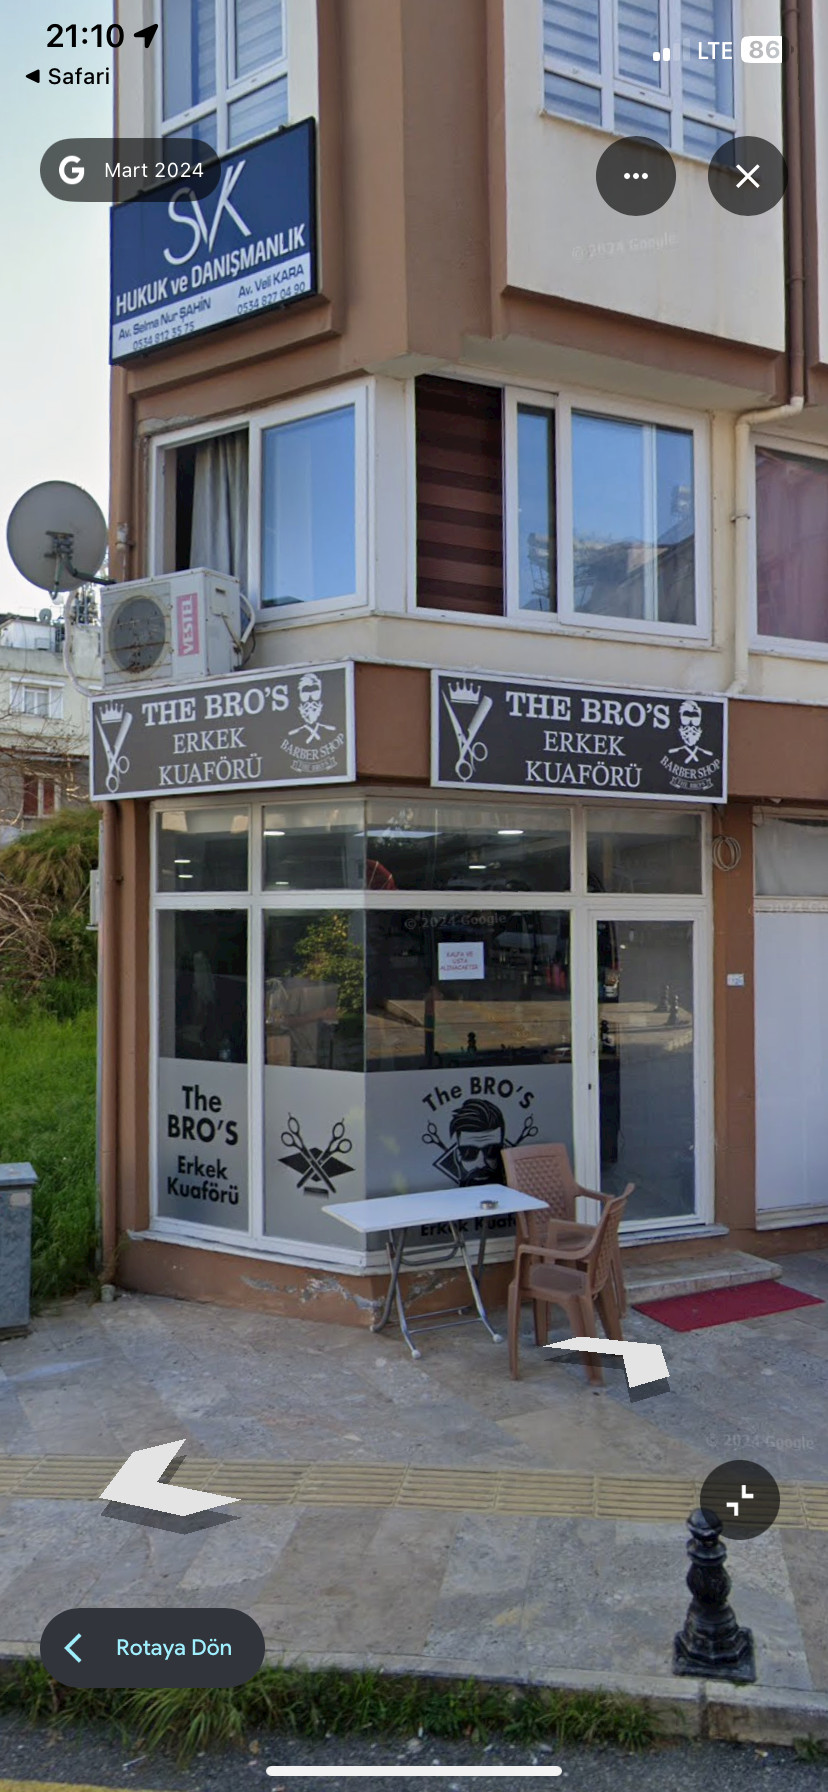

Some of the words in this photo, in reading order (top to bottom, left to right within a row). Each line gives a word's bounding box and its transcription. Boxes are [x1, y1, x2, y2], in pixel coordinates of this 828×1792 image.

[115, 277, 168, 317] HUKUK
[170, 275, 189, 295] ve
[191, 223, 306, 289] DANIŞMANLIK
[273, 264, 304, 286] KARA
[237, 298, 259, 315] 0534
[142, 697, 196, 727] THE
[204, 684, 290, 720] BRO'S
[505, 690, 571, 722] THE
[581, 698, 671, 730] BRO'S
[173, 727, 247, 755] ERKEK
[280, 739, 319, 761] BARBER
[319, 732, 345, 758] SHOP
[543, 730, 626, 757] ERKEK
[158, 752, 264, 786] KUAFÖRÜ
[525, 761, 643, 788] KUAFÖRÜ
[659, 755, 698, 780] BARBER
[697, 758, 720, 779] SHOP
[182, 1084, 222, 1113] The
[422, 1085, 462, 1112] The
[470, 1076, 535, 1109] BRO'S
[167, 1114, 239, 1146] BRO'S
[178, 1155, 228, 1180] Erkek
[167, 1176, 239, 1205] Kuaförü
